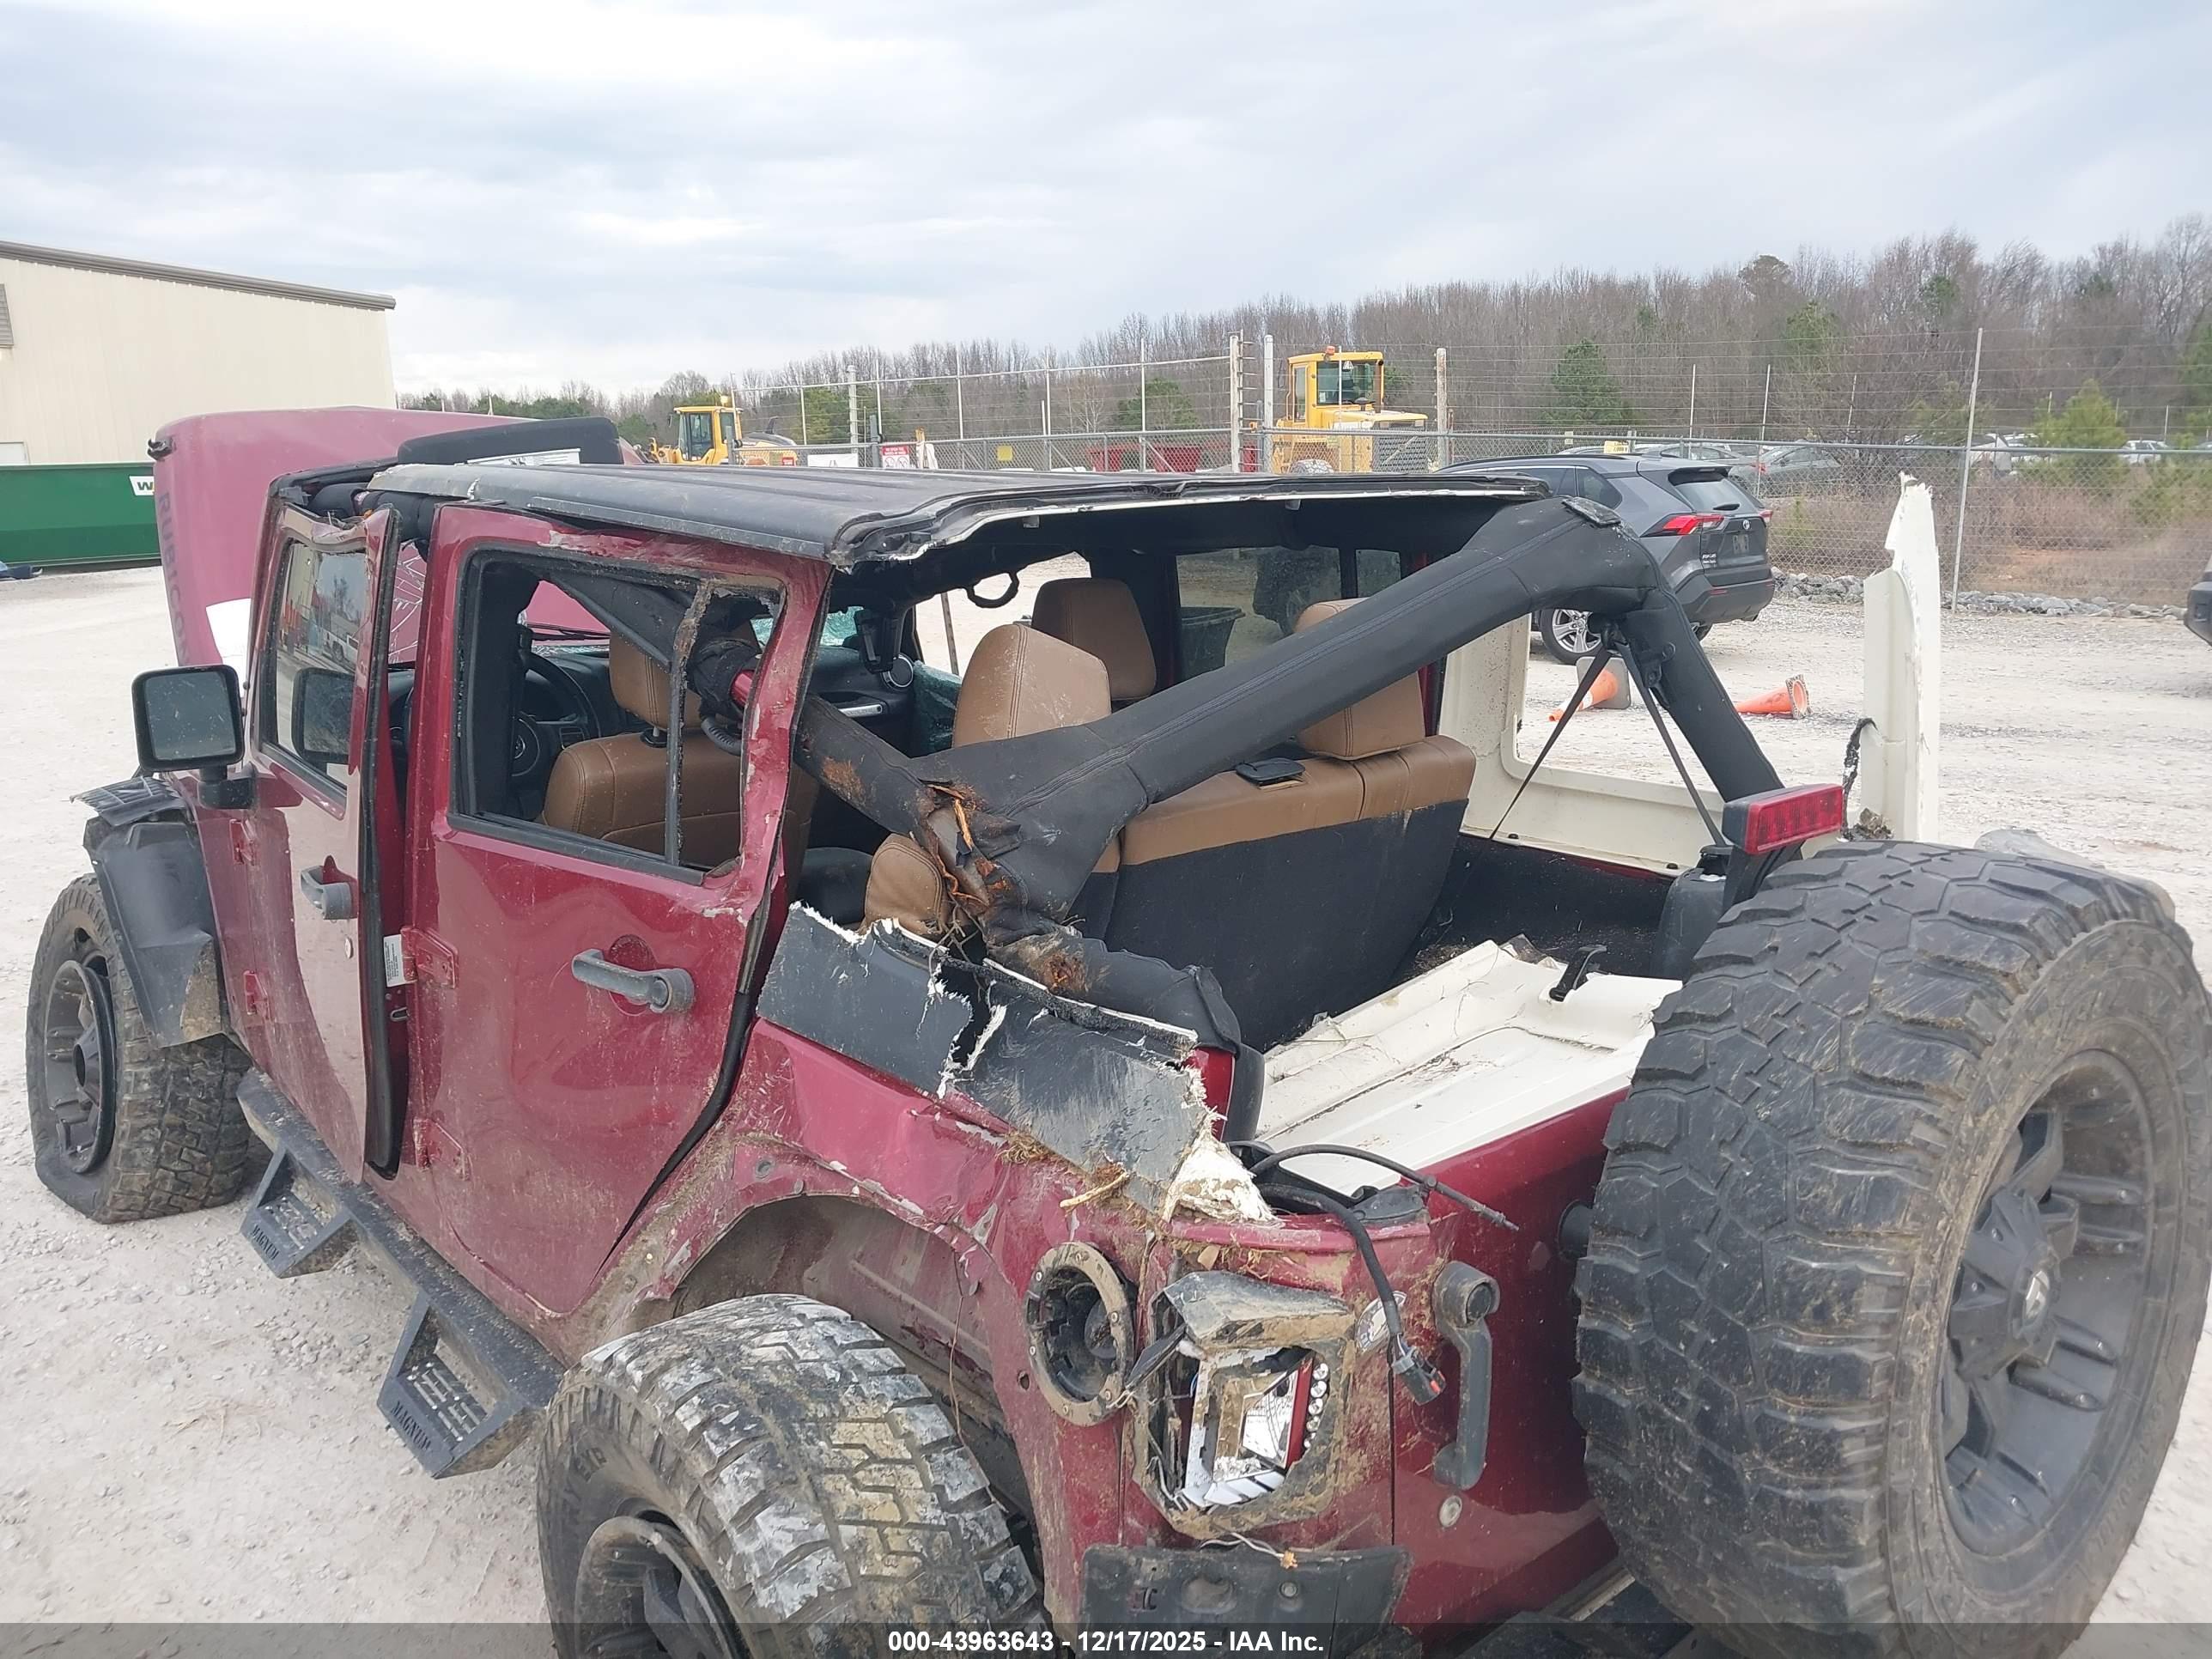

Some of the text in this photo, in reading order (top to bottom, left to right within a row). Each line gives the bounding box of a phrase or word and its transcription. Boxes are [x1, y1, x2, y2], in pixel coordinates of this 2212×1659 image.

[157, 492, 191, 666] RUBICON
[249, 1224, 280, 1261] MAGNUM
[390, 1400, 432, 1451] MAGNUM
